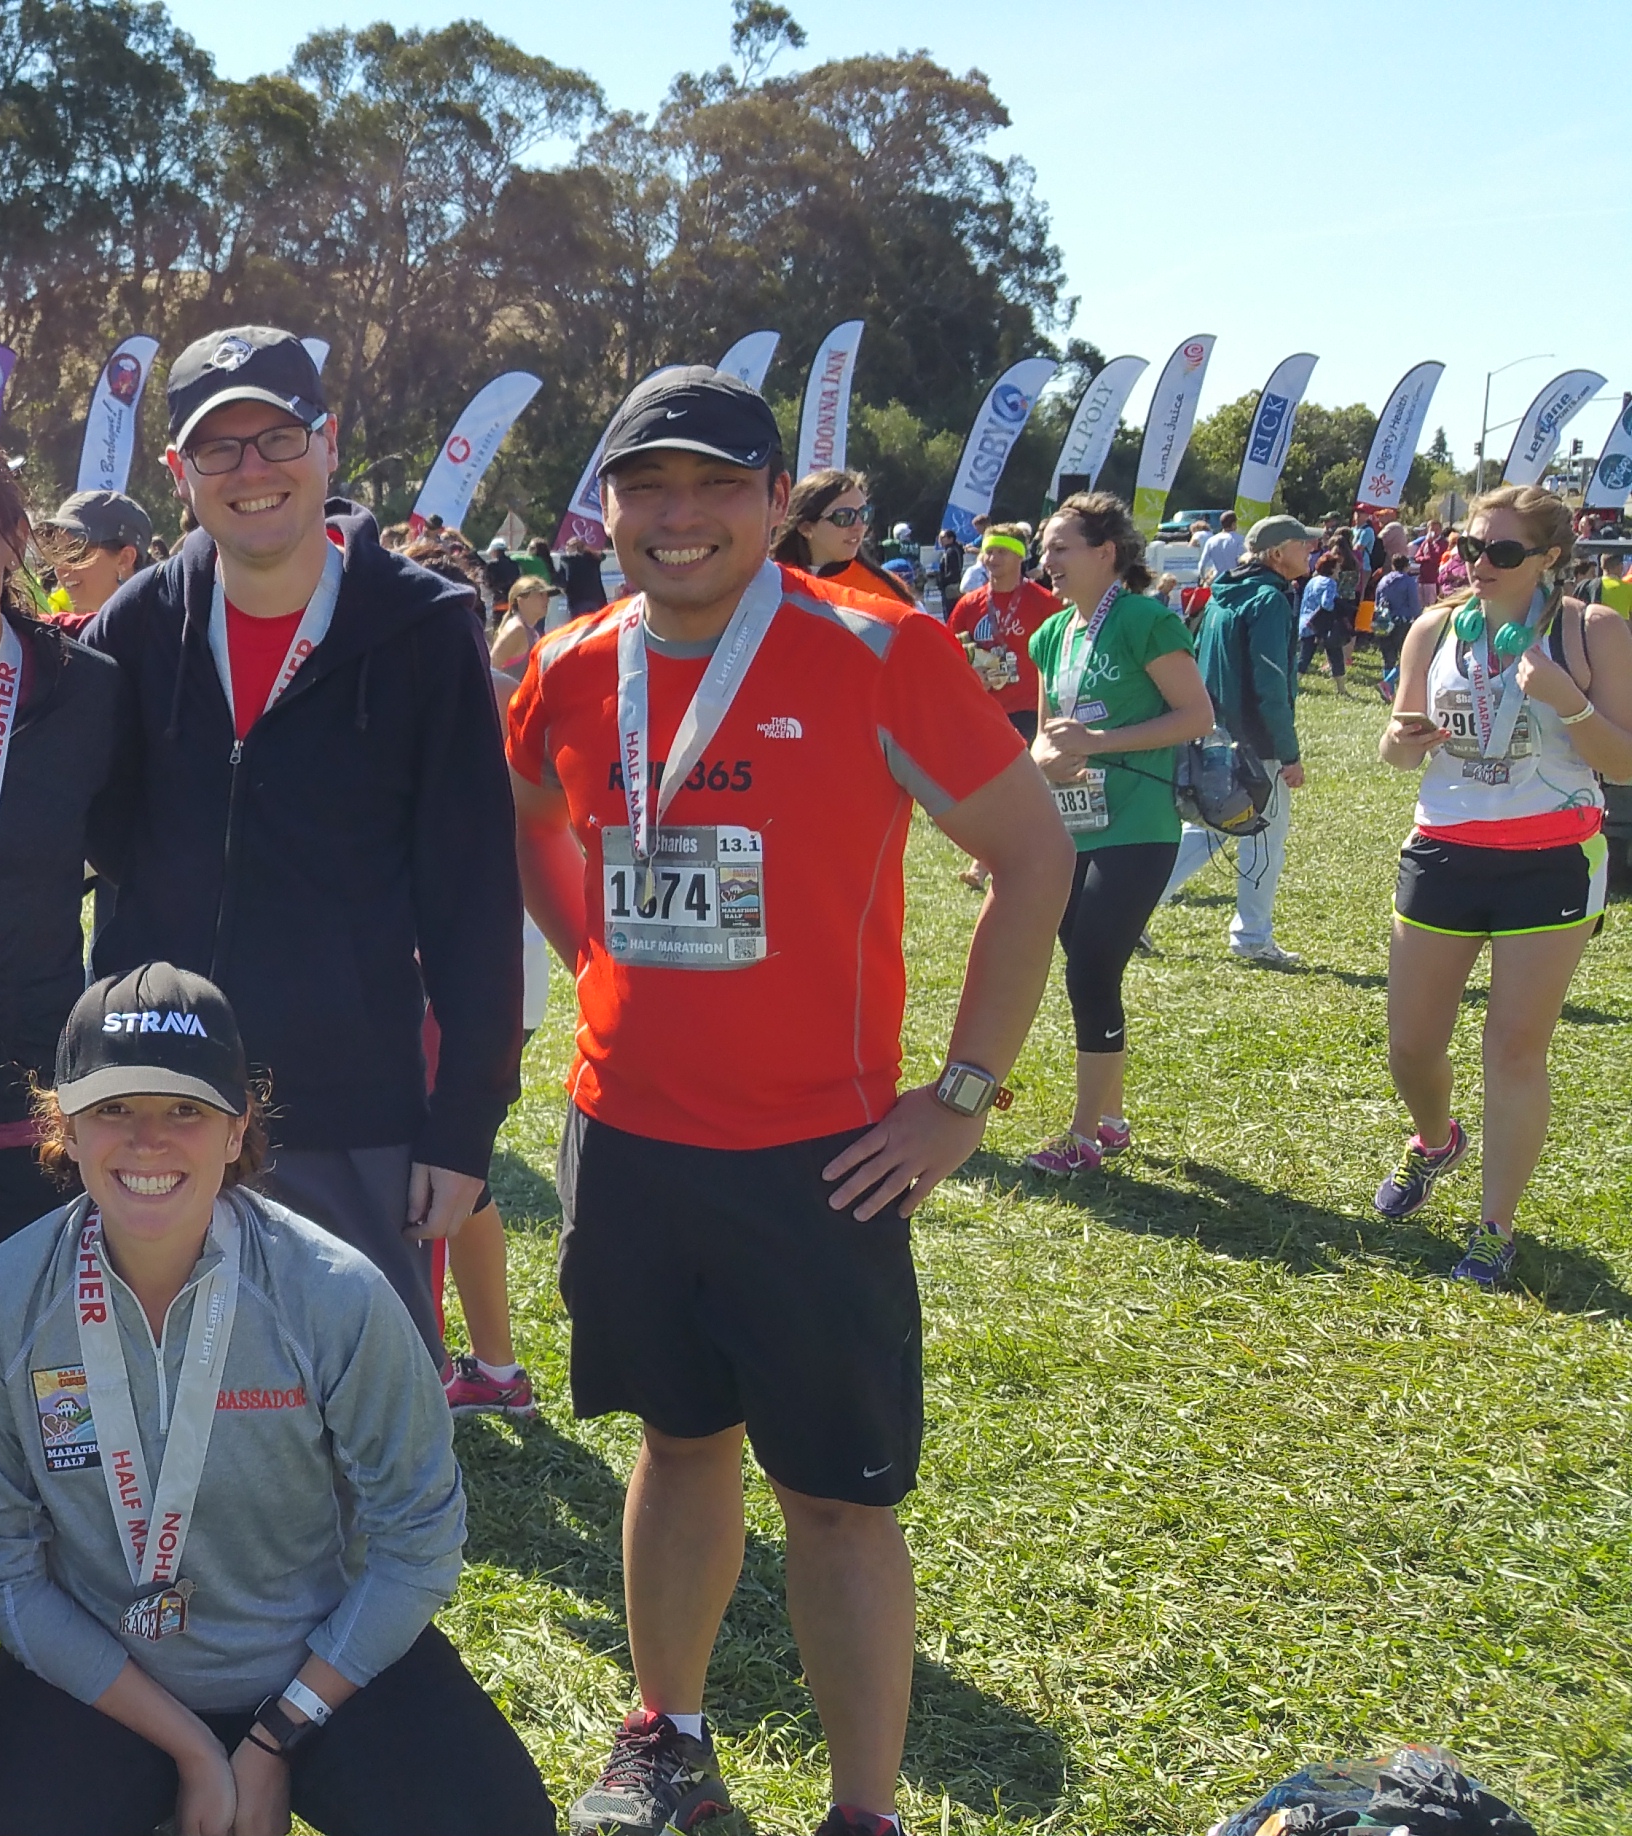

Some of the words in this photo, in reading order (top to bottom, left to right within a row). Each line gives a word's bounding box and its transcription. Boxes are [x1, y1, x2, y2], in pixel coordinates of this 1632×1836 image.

[821, 349, 848, 386] INN
[1076, 381, 1114, 440] POLY
[1164, 392, 1185, 431] juice
[1253, 397, 1284, 461] RICK
[1376, 432, 1398, 471] Dignity
[1389, 394, 1409, 431] Health
[965, 416, 1016, 498] KSBY
[1154, 434, 1175, 482] jamba
[1472, 664, 1485, 691] HALF
[626, 731, 640, 781] HALF
[719, 837, 761, 852] 13.1
[630, 938, 658, 950] HALF
[658, 941, 723, 954] MARATHON
[102, 1010, 208, 1038] STRAVA
[47, 1444, 99, 1459] MARATH
[112, 1450, 143, 1510] HALF
[121, 1609, 157, 1640] RACE
